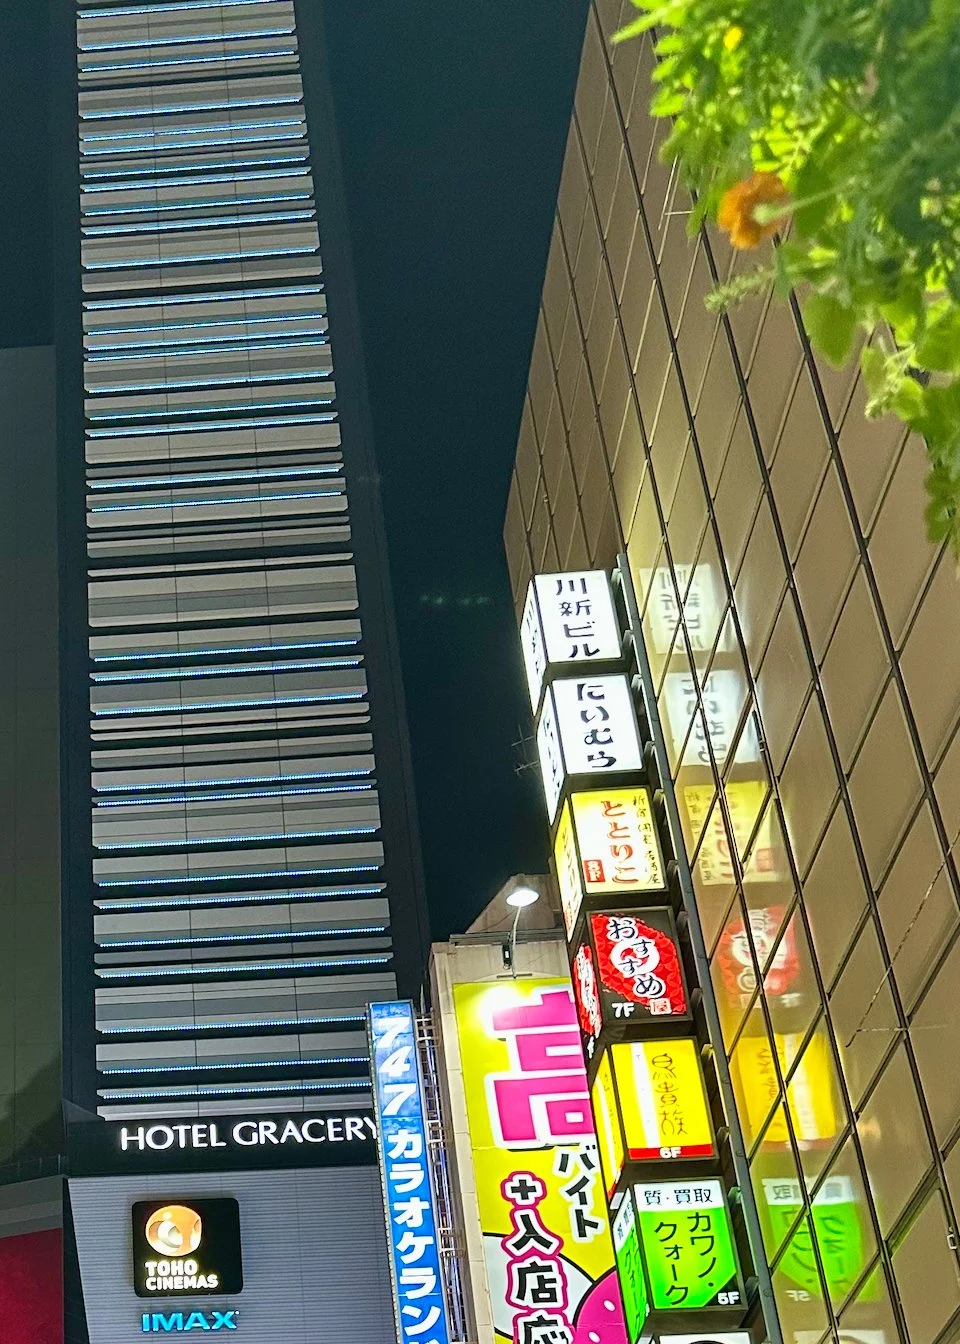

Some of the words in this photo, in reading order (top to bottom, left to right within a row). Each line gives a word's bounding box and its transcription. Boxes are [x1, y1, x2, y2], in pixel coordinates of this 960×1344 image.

[556, 577, 601, 658] 川新ビル
[577, 683, 617, 769] にいむら
[608, 918, 665, 998] おすすめ
[612, 1003, 635, 1017] 7F
[374, 1015, 417, 1117] 747
[121, 1123, 226, 1151] HOTEL
[232, 1117, 378, 1146] GRACERY
[660, 1147, 681, 1159] 6F
[559, 1145, 600, 1238] バイト
[144, 1259, 198, 1277] TOHO
[654, 1221, 689, 1306] クォーク
[145, 1274, 218, 1291] CINEMAS
[717, 1291, 740, 1305] 5F
[141, 1310, 238, 1332] IMAX
